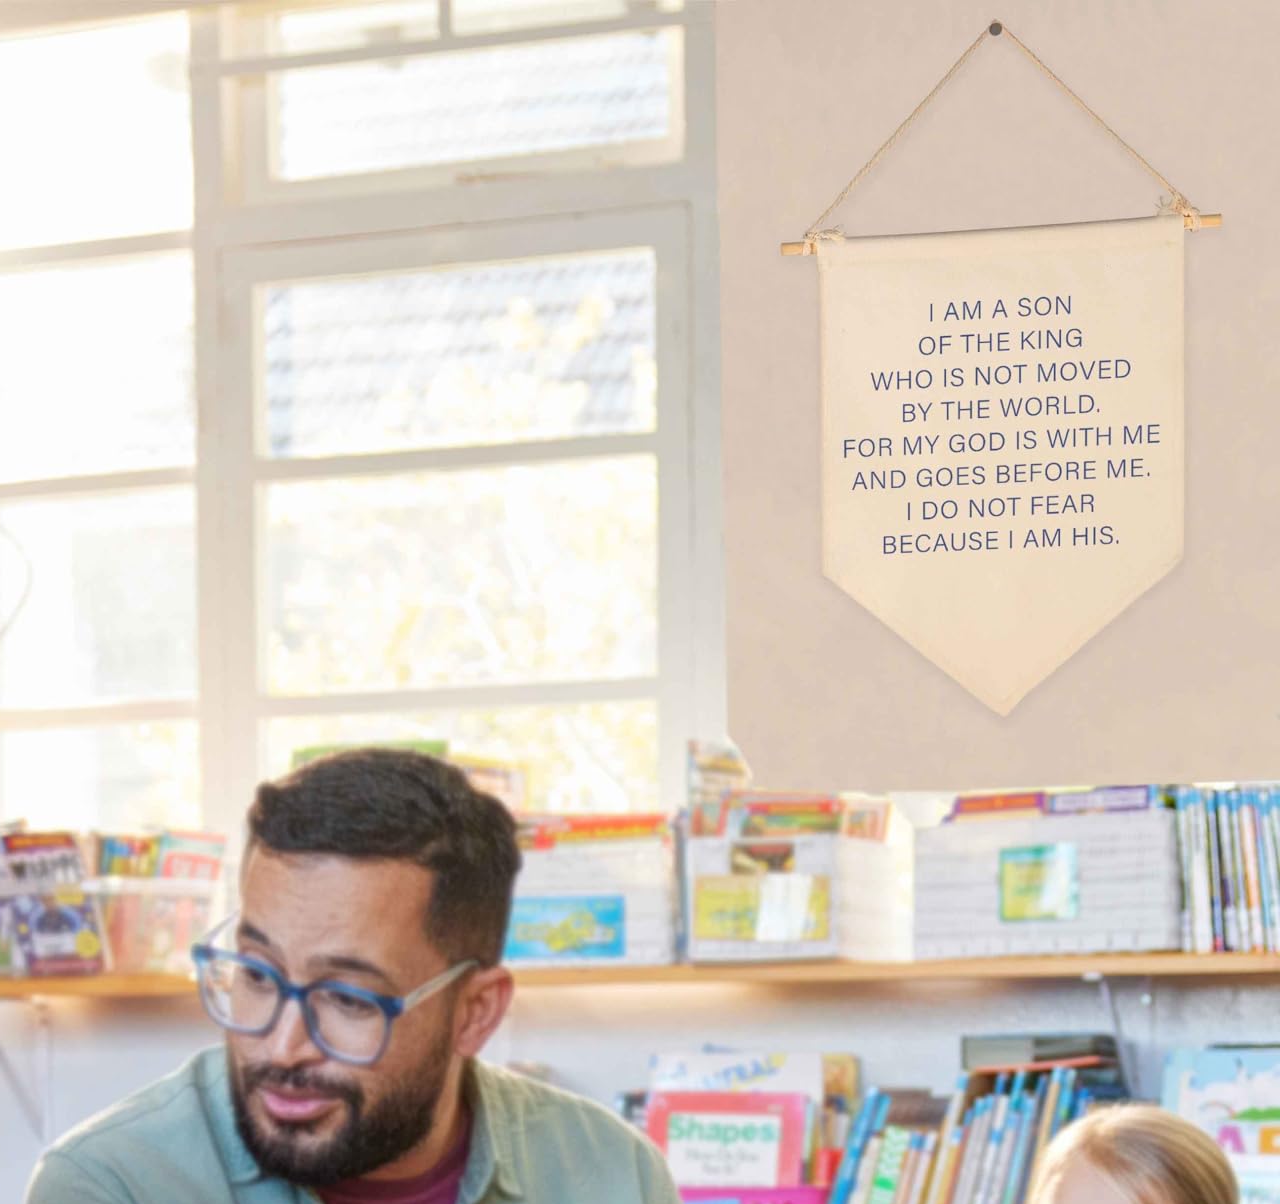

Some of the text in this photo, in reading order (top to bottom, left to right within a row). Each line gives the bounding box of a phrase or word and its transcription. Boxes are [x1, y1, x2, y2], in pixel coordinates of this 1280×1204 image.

[943, 300, 983, 322] AM
[991, 298, 1010, 319] A
[1017, 295, 1073, 318] SON
[918, 327, 1084, 356] OF THE KING
[870, 358, 1133, 392] WHO IS NOT MOVED
[902, 394, 1101, 423] BY THE WORLD.
[843, 423, 1162, 459] FOR MY GOD IS WITH ME
[851, 457, 1152, 491] AND GOES BEFORE ME.
[922, 499, 960, 521] DO
[968, 496, 1023, 519] NOT
[1030, 493, 1096, 516] FEAR
[882, 530, 1000, 555] BECAUSE
[1023, 528, 1062, 549] AM
[1072, 525, 1121, 547] HIS.
[669, 1113, 777, 1145] Shapes
